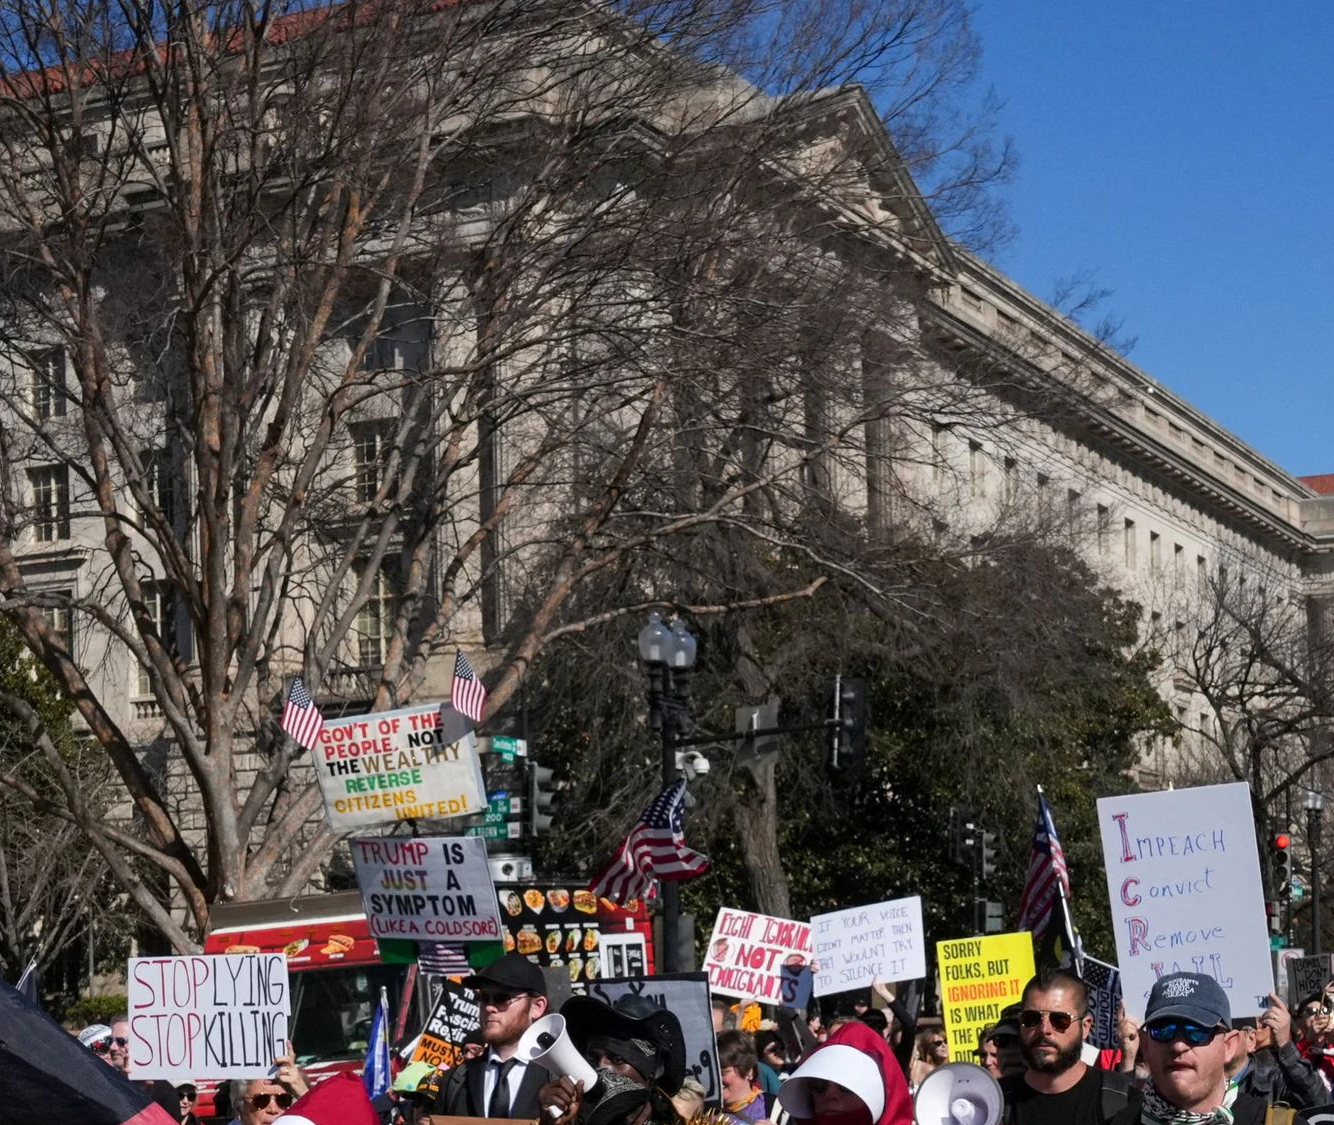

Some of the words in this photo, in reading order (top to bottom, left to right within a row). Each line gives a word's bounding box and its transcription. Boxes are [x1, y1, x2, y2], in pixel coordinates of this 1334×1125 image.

[319, 722, 369, 744] GOV'T
[378, 718, 400, 735] OF
[409, 712, 444, 729] THE
[407, 728, 444, 748] NOT
[326, 758, 360, 777] THE
[361, 742, 460, 774] WEALTHY
[345, 769, 422, 793] REVERSE
[334, 790, 417, 814] CITIZENS
[395, 794, 468, 820] UNITED!
[486, 814, 502, 823] 200
[356, 842, 429, 866] TRUMP
[443, 843, 465, 865] IS
[381, 869, 427, 891] JUST
[446, 869, 462, 891] A
[371, 894, 477, 916] SYMPTOM
[718, 912, 758, 939] FIGHT
[818, 919, 833, 934] IF
[841, 914, 870, 929] YOUR
[879, 906, 908, 922] VOICE
[891, 923, 913, 937] THEN
[893, 938, 914, 953] TRY
[1125, 916, 1225, 956] Remove
[735, 943, 784, 971] NOT
[943, 941, 982, 959] SORRY
[134, 958, 209, 1009] STOP
[213, 955, 284, 1007] LYING
[818, 976, 833, 989] TO
[840, 962, 884, 985] SILENCE
[891, 958, 906, 975] IT
[945, 961, 985, 981] FOLKS,
[987, 959, 1009, 976] BUT
[464, 988, 475, 999] Th
[706, 962, 800, 1003] IMMIGRANTS
[947, 982, 1007, 1002] IGNORING
[1010, 979, 1020, 996] IT
[1299, 979, 1323, 991] HIDE
[448, 991, 480, 1018] Trum
[950, 1008, 960, 1024] IS
[961, 1003, 999, 1023] WHAT
[131, 1012, 201, 1069] STOP
[203, 1011, 286, 1067] KILLING
[952, 1027, 976, 1045] THE
